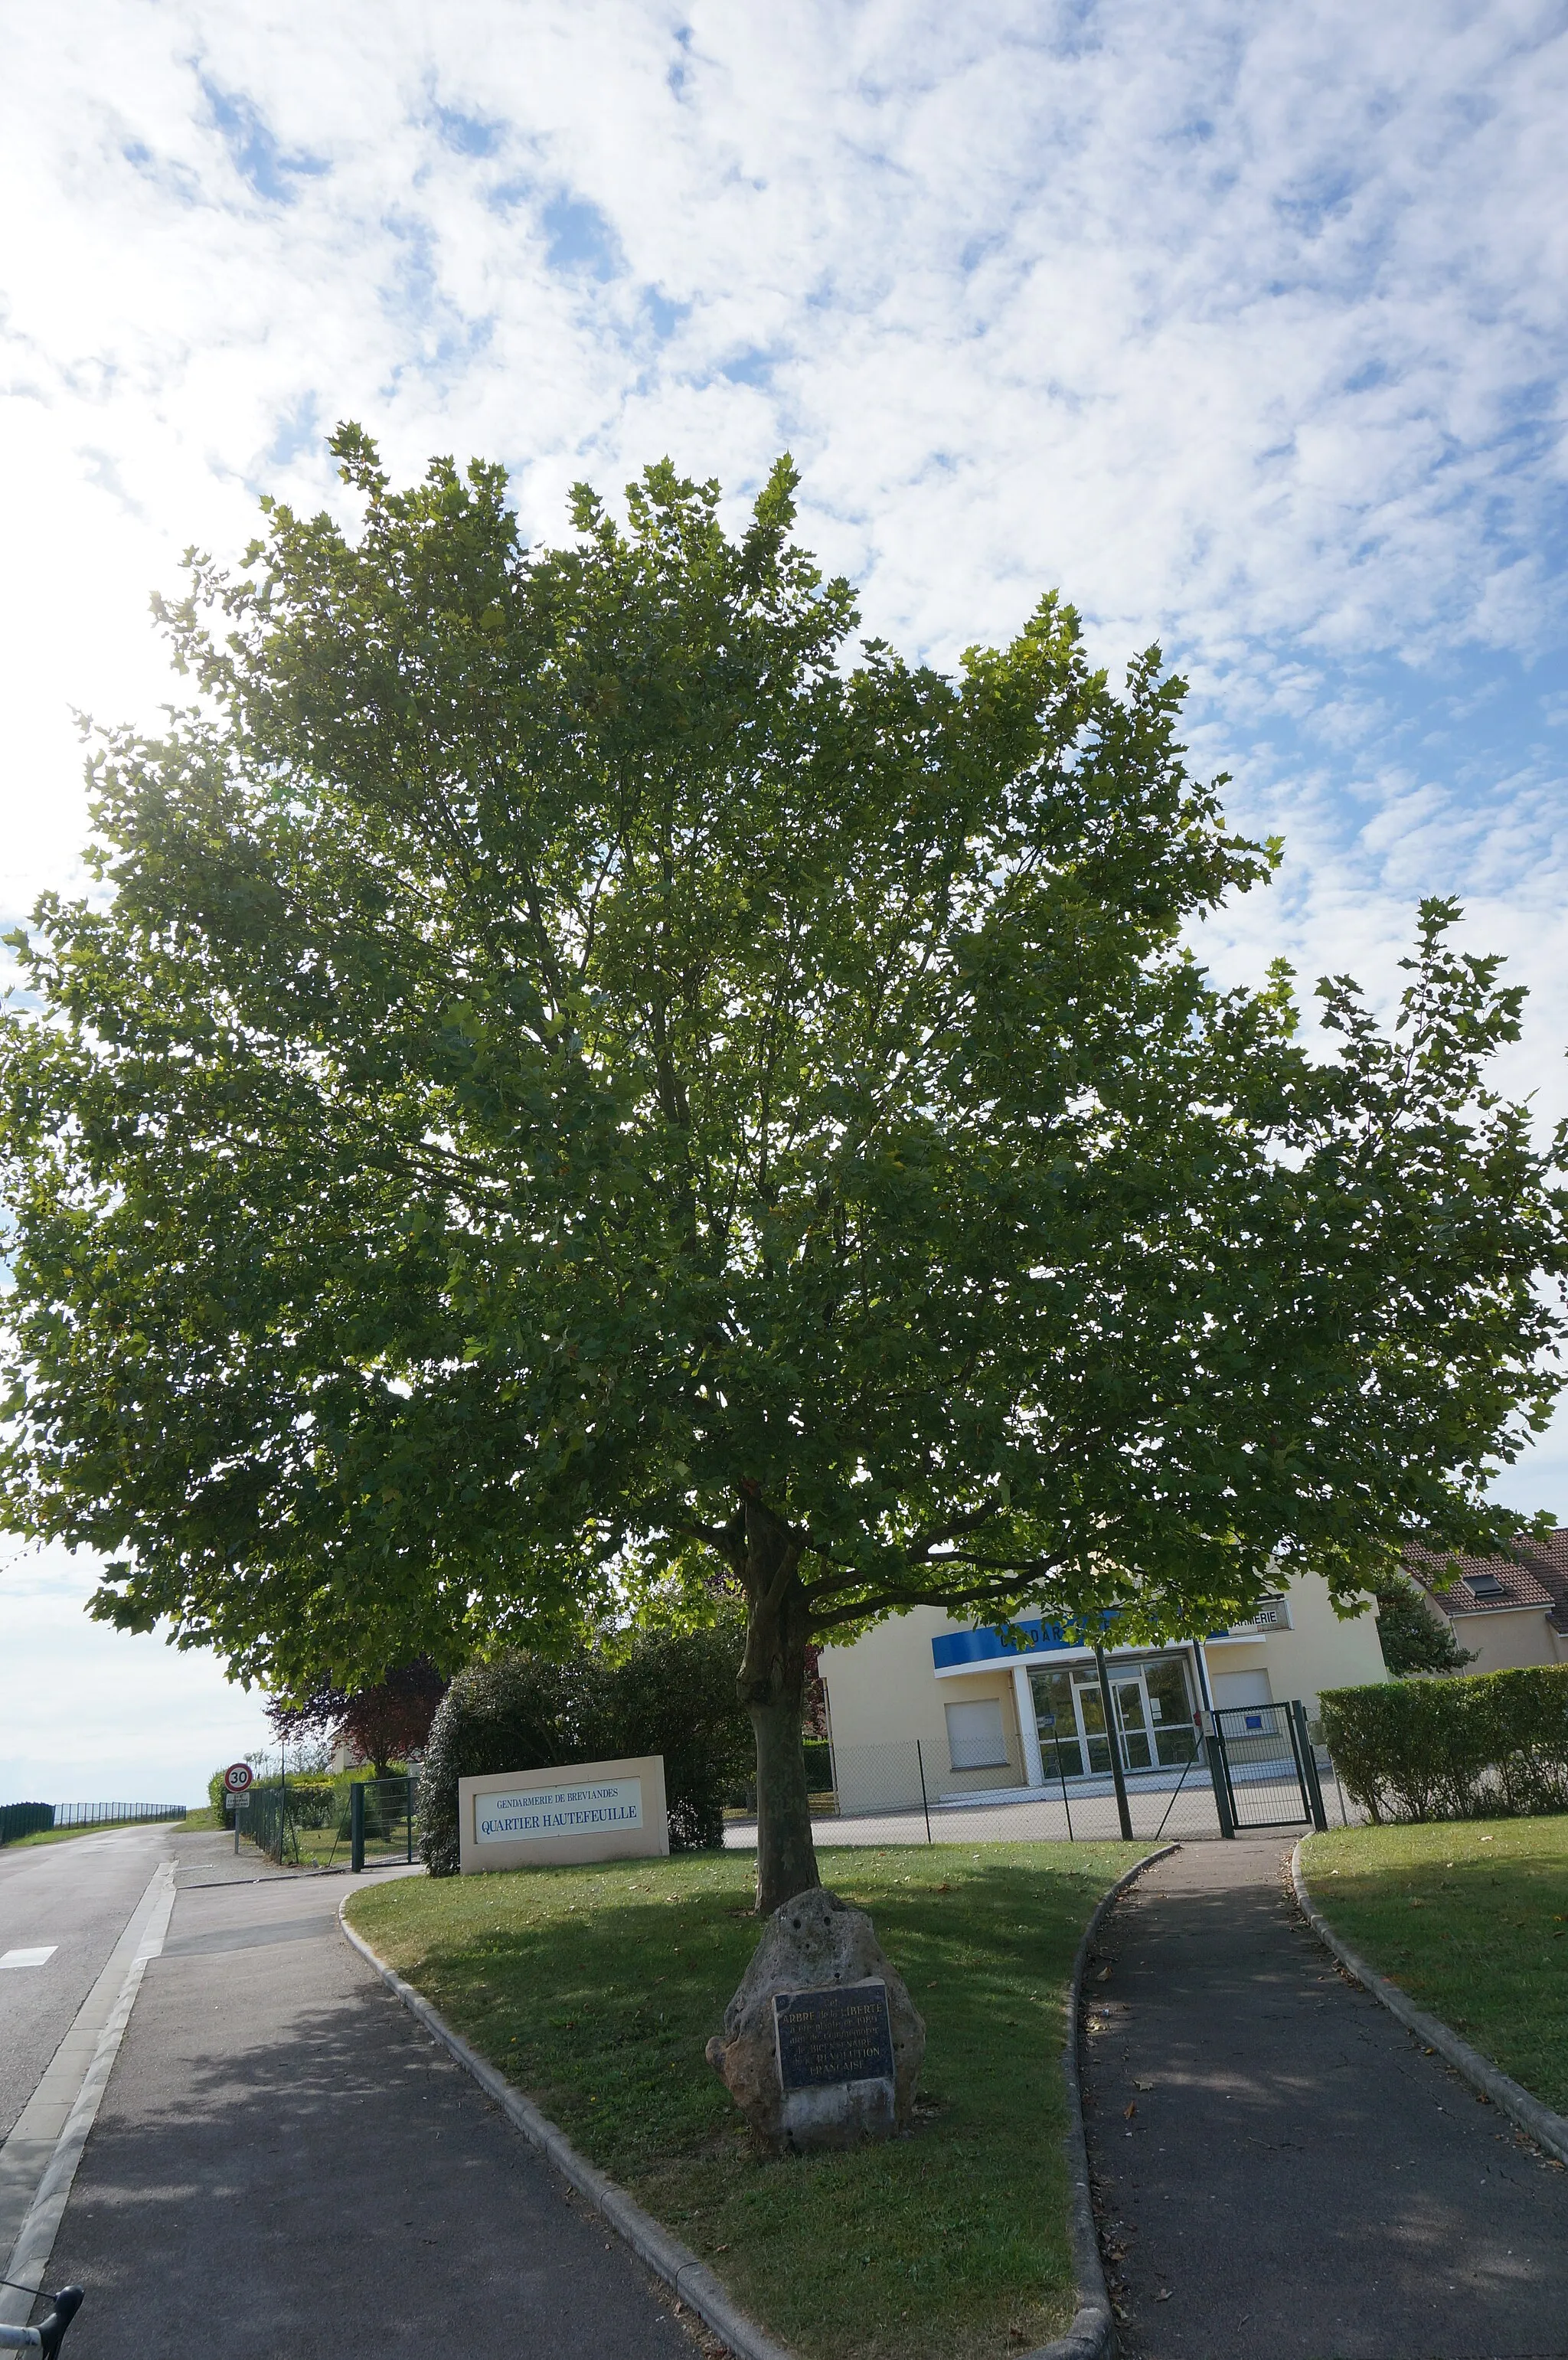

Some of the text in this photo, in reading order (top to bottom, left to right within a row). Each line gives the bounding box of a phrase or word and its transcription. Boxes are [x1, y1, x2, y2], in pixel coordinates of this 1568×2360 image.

[1228, 1611, 1277, 1628] ARMERIE
[230, 1771, 247, 1784] 30
[497, 1788, 619, 1809] GENDARMERIE DE BREVIANDES
[482, 1806, 637, 1835] QUARTIER HAUTEFEUILLE
[782, 2012, 815, 2023] ARBRE
[841, 2002, 882, 2017] LIBERTÉ
